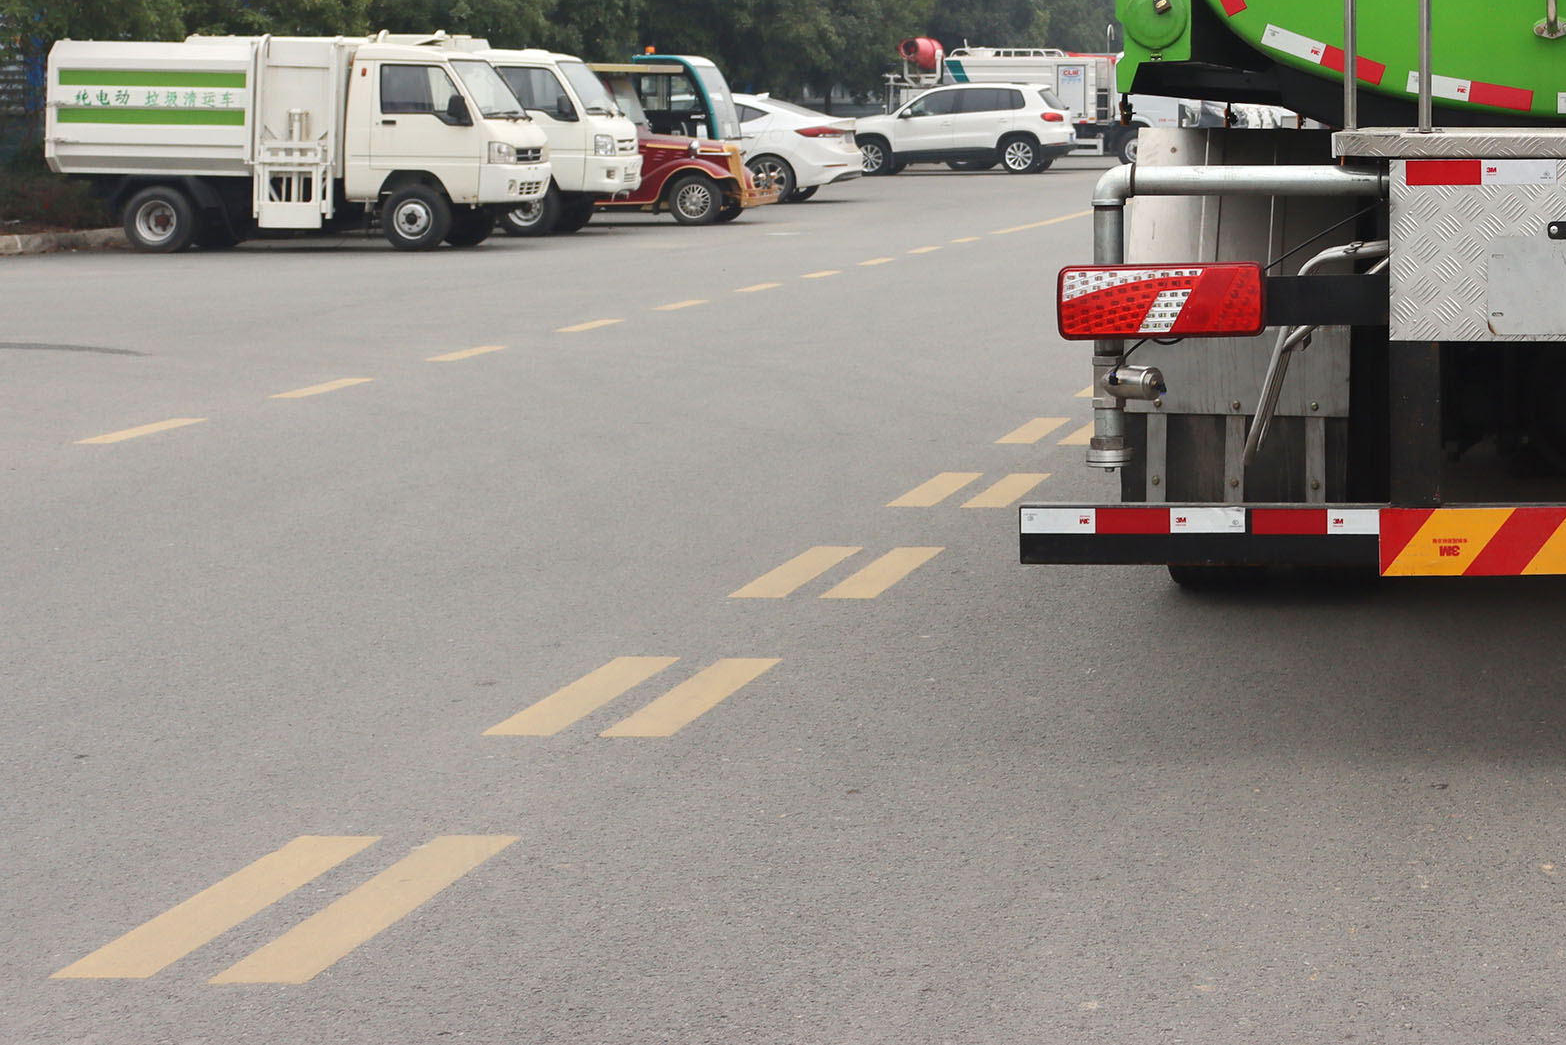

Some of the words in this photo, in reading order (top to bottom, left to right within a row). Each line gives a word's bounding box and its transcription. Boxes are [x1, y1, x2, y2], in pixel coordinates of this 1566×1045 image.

[75, 89, 130, 107] 纯电动
[145, 90, 235, 107] 垃圾清运车
[1439, 545, 1460, 557] 3M
